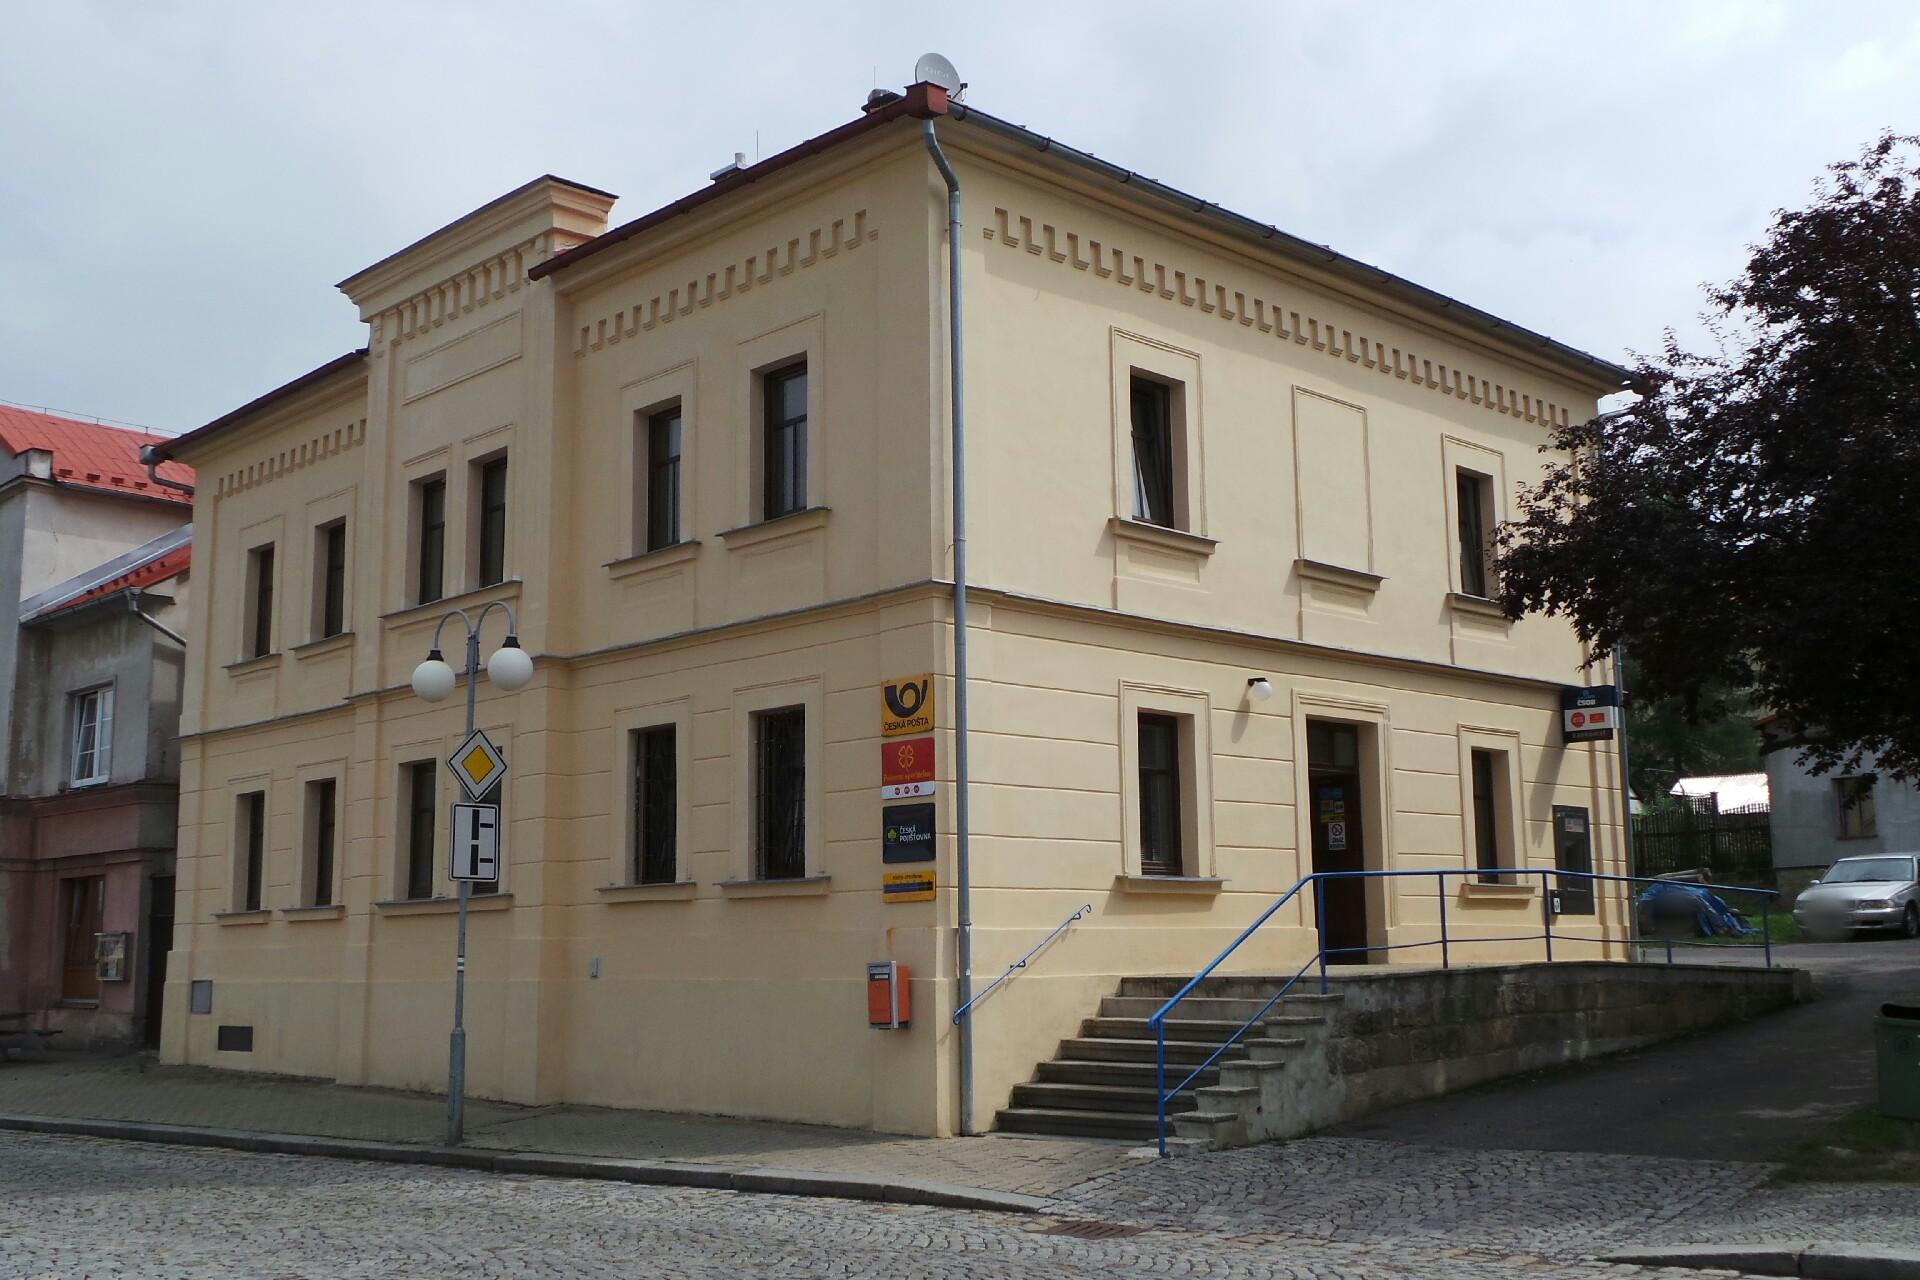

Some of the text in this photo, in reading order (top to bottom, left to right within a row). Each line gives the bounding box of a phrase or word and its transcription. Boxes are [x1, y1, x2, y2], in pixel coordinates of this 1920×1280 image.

[884, 717, 929, 731] ČESKÁ POŠTA
[900, 824, 916, 834] ČESKÁ
[900, 832, 932, 843] POJIŠŤOVNA
